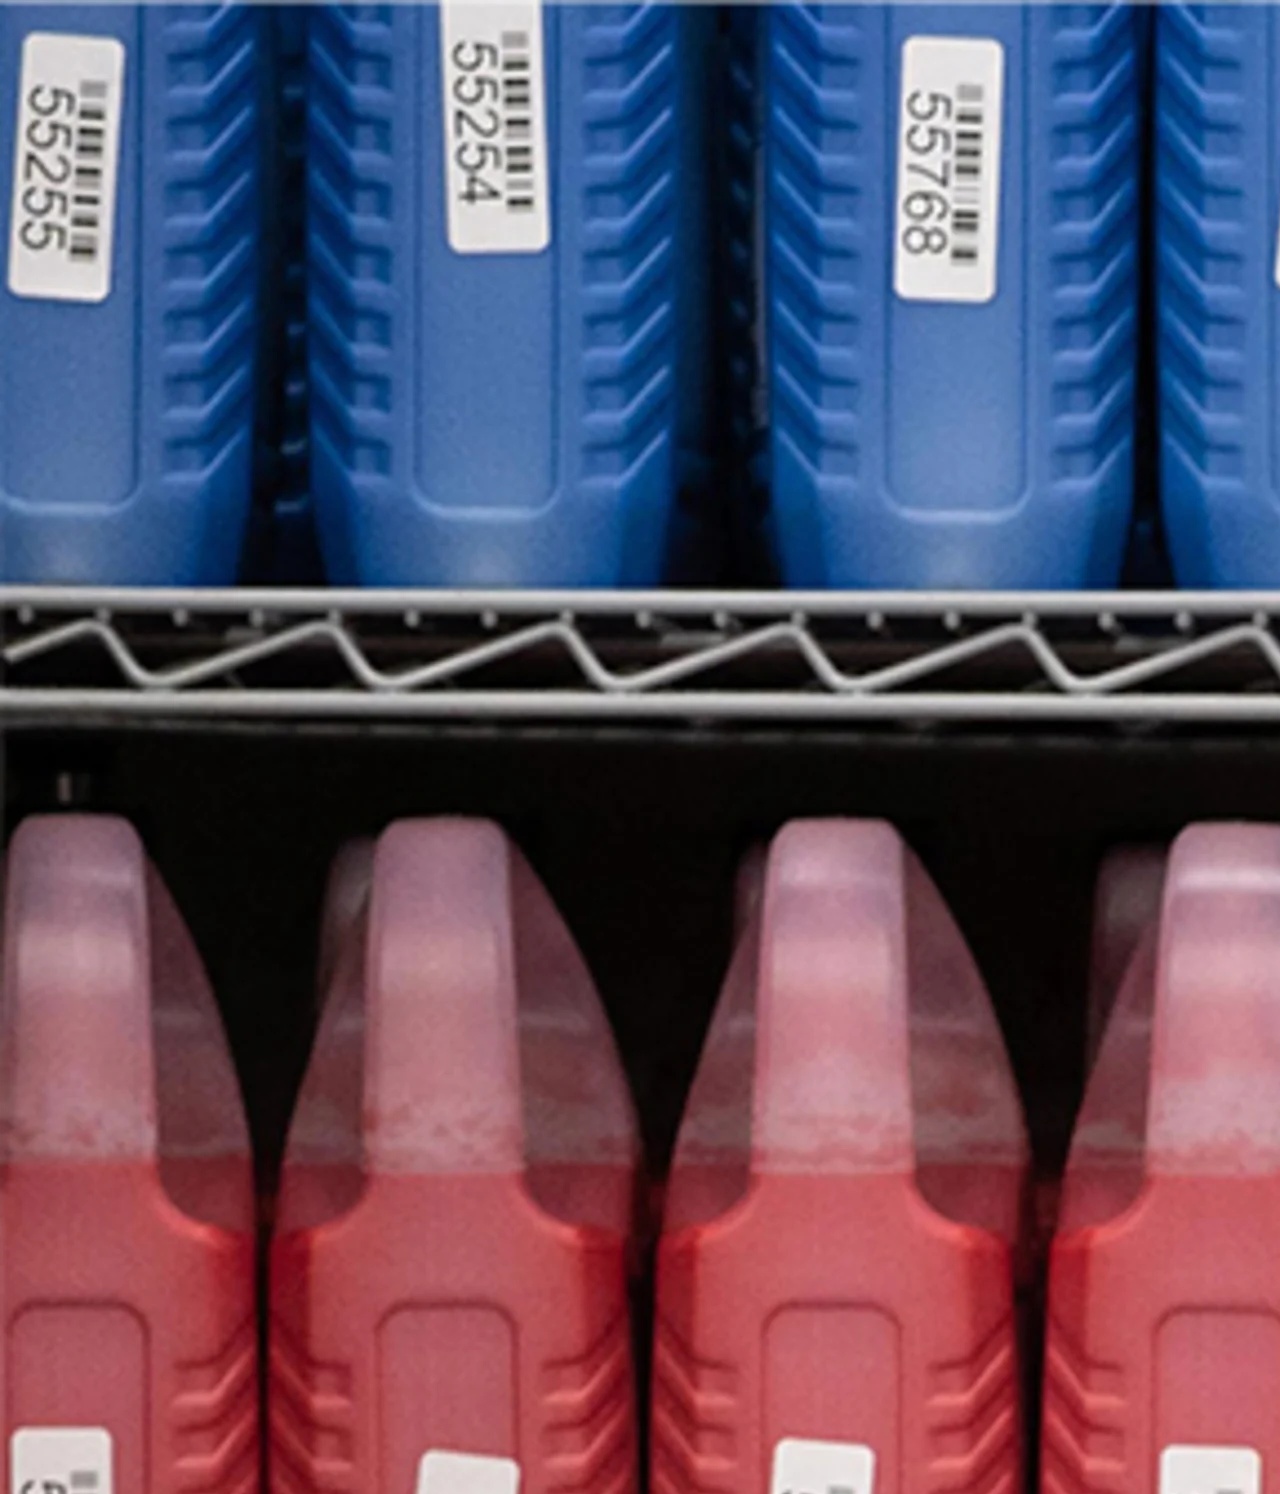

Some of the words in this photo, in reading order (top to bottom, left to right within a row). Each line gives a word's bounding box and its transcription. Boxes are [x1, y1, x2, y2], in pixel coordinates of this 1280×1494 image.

[20, 84, 75, 253] 55255
[452, 40, 504, 206] 55254
[902, 89, 952, 256] 55768
